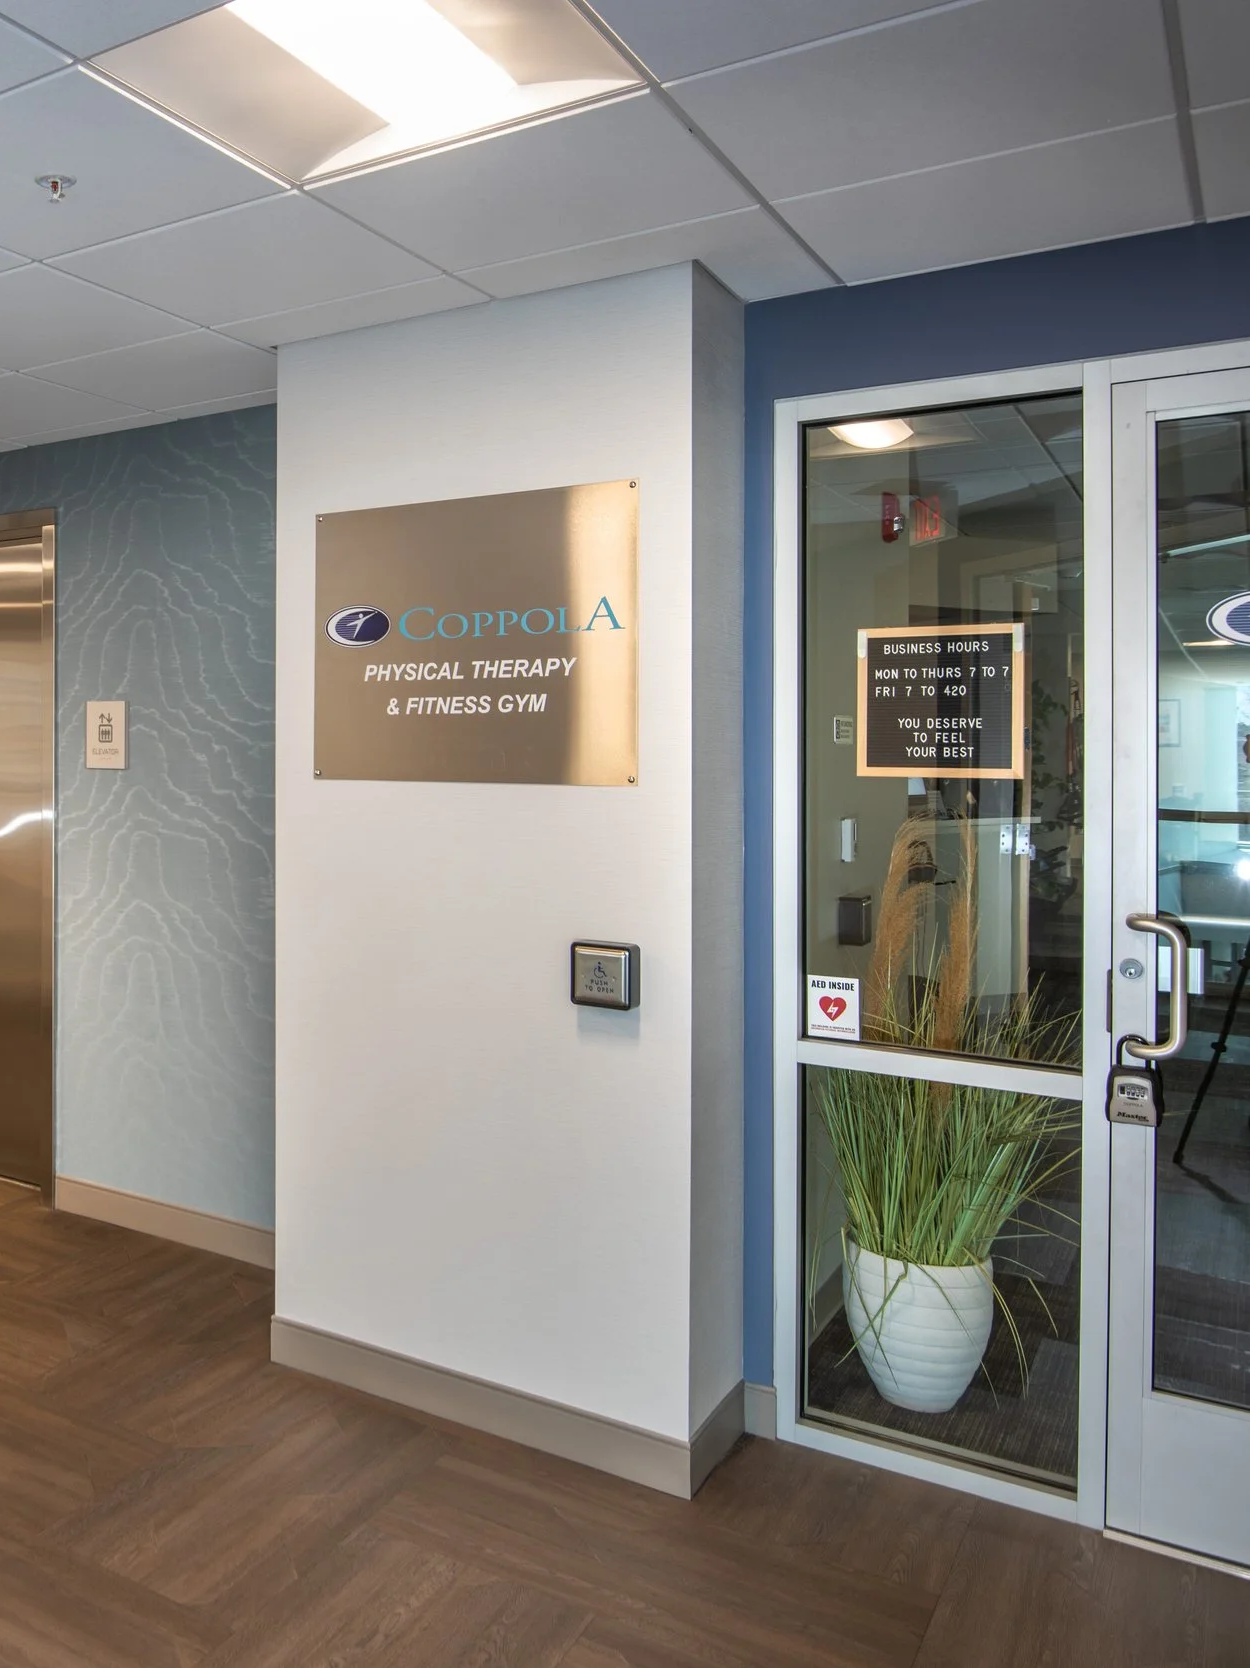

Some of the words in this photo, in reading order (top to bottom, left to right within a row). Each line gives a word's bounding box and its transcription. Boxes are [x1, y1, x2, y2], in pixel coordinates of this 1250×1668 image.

[398, 596, 626, 641] COPPOLA
[883, 642, 942, 655] BUSINESS
[947, 641, 990, 653] HOURS
[364, 661, 464, 682] PHYSICAL
[471, 657, 578, 679] THERAPY
[874, 669, 899, 680] MON
[903, 668, 917, 679] TO
[921, 667, 962, 678] THURS
[969, 667, 976, 678] 7
[982, 666, 996, 677] TO
[1002, 666, 1010, 677] 7
[875, 686, 896, 697] FRI
[905, 686, 912, 697] 7
[921, 685, 935, 696] TO
[943, 685, 967, 696] 420
[387, 698, 400, 715] &
[405, 695, 492, 715] FITNESS
[497, 693, 548, 714] GYM
[898, 718, 920, 729] YOU
[927, 718, 983, 729] DESERVE
[913, 732, 928, 743] TO
[935, 732, 966, 743] FEEL
[906, 746, 937, 758] YOUR
[943, 747, 974, 758] BEST
[597, 986, 614, 994] OPEN
[811, 980, 826, 989] AED
[829, 981, 855, 991] INSIDE
